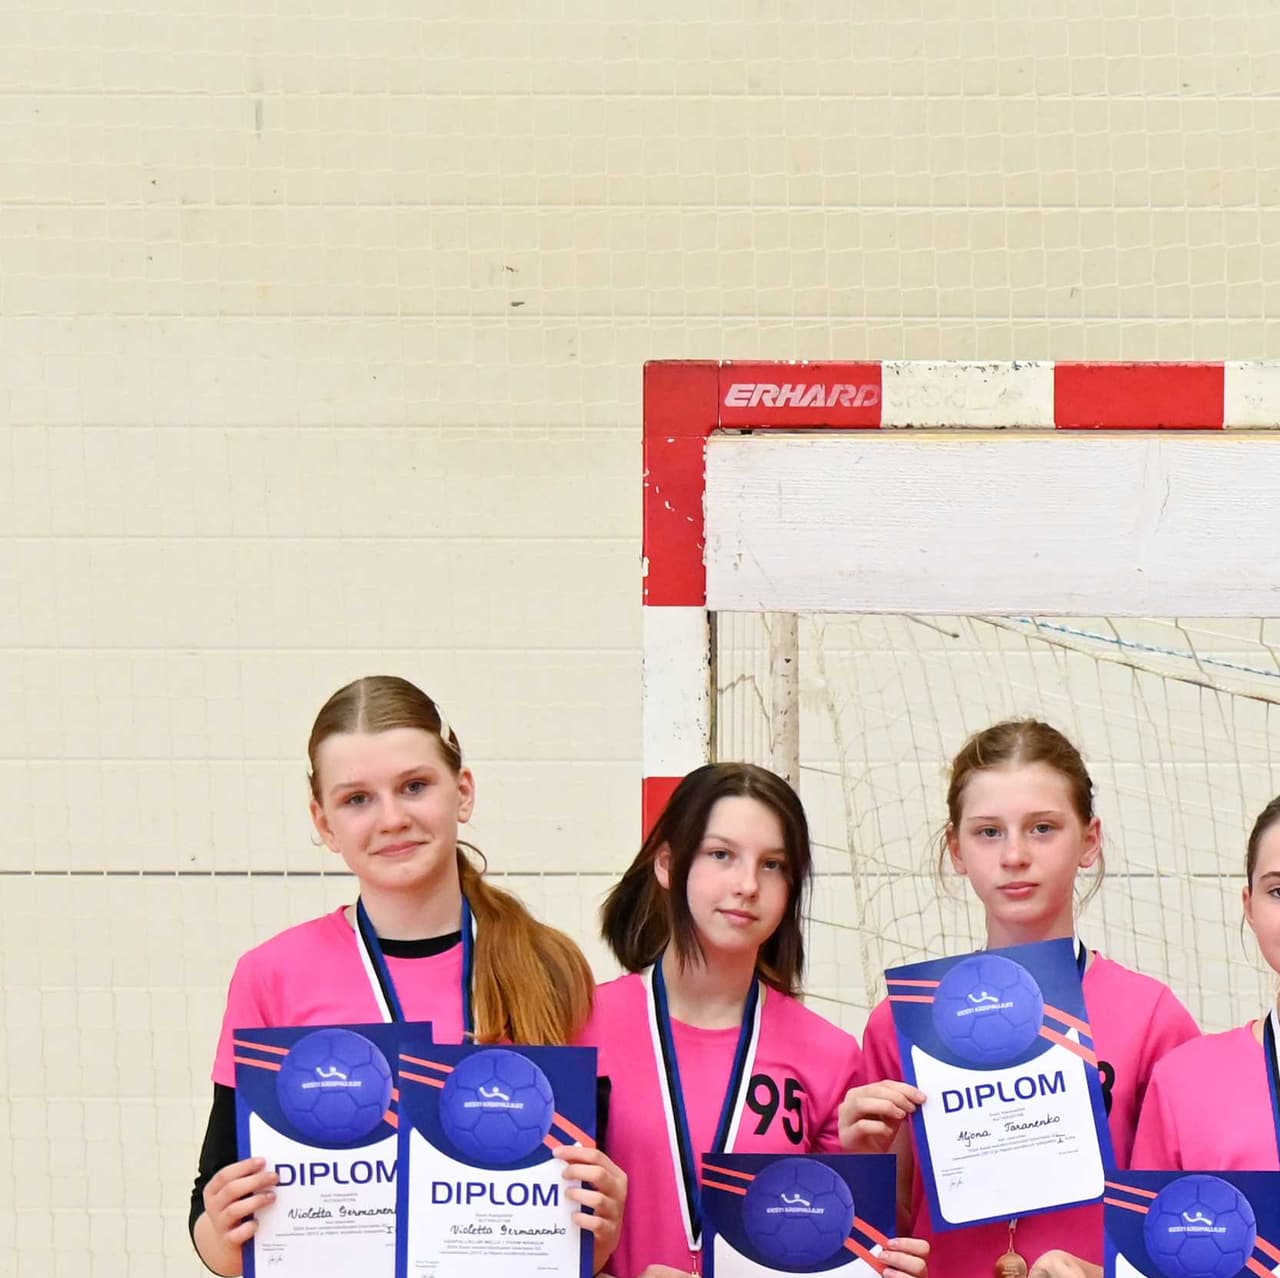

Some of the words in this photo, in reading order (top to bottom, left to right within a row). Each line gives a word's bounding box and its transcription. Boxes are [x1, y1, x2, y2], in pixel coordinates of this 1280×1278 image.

[723, 383, 880, 408] ERHARD
[941, 1070, 1066, 1114] DIPLOM
[743, 1073, 805, 1145] 95
[275, 1159, 398, 1187] DIPLOM
[431, 1181, 559, 1207] DIPLOM
[287, 1206, 333, 1220] Violetta
[339, 1205, 397, 1218] Germanen
[450, 1223, 493, 1235] Violetta
